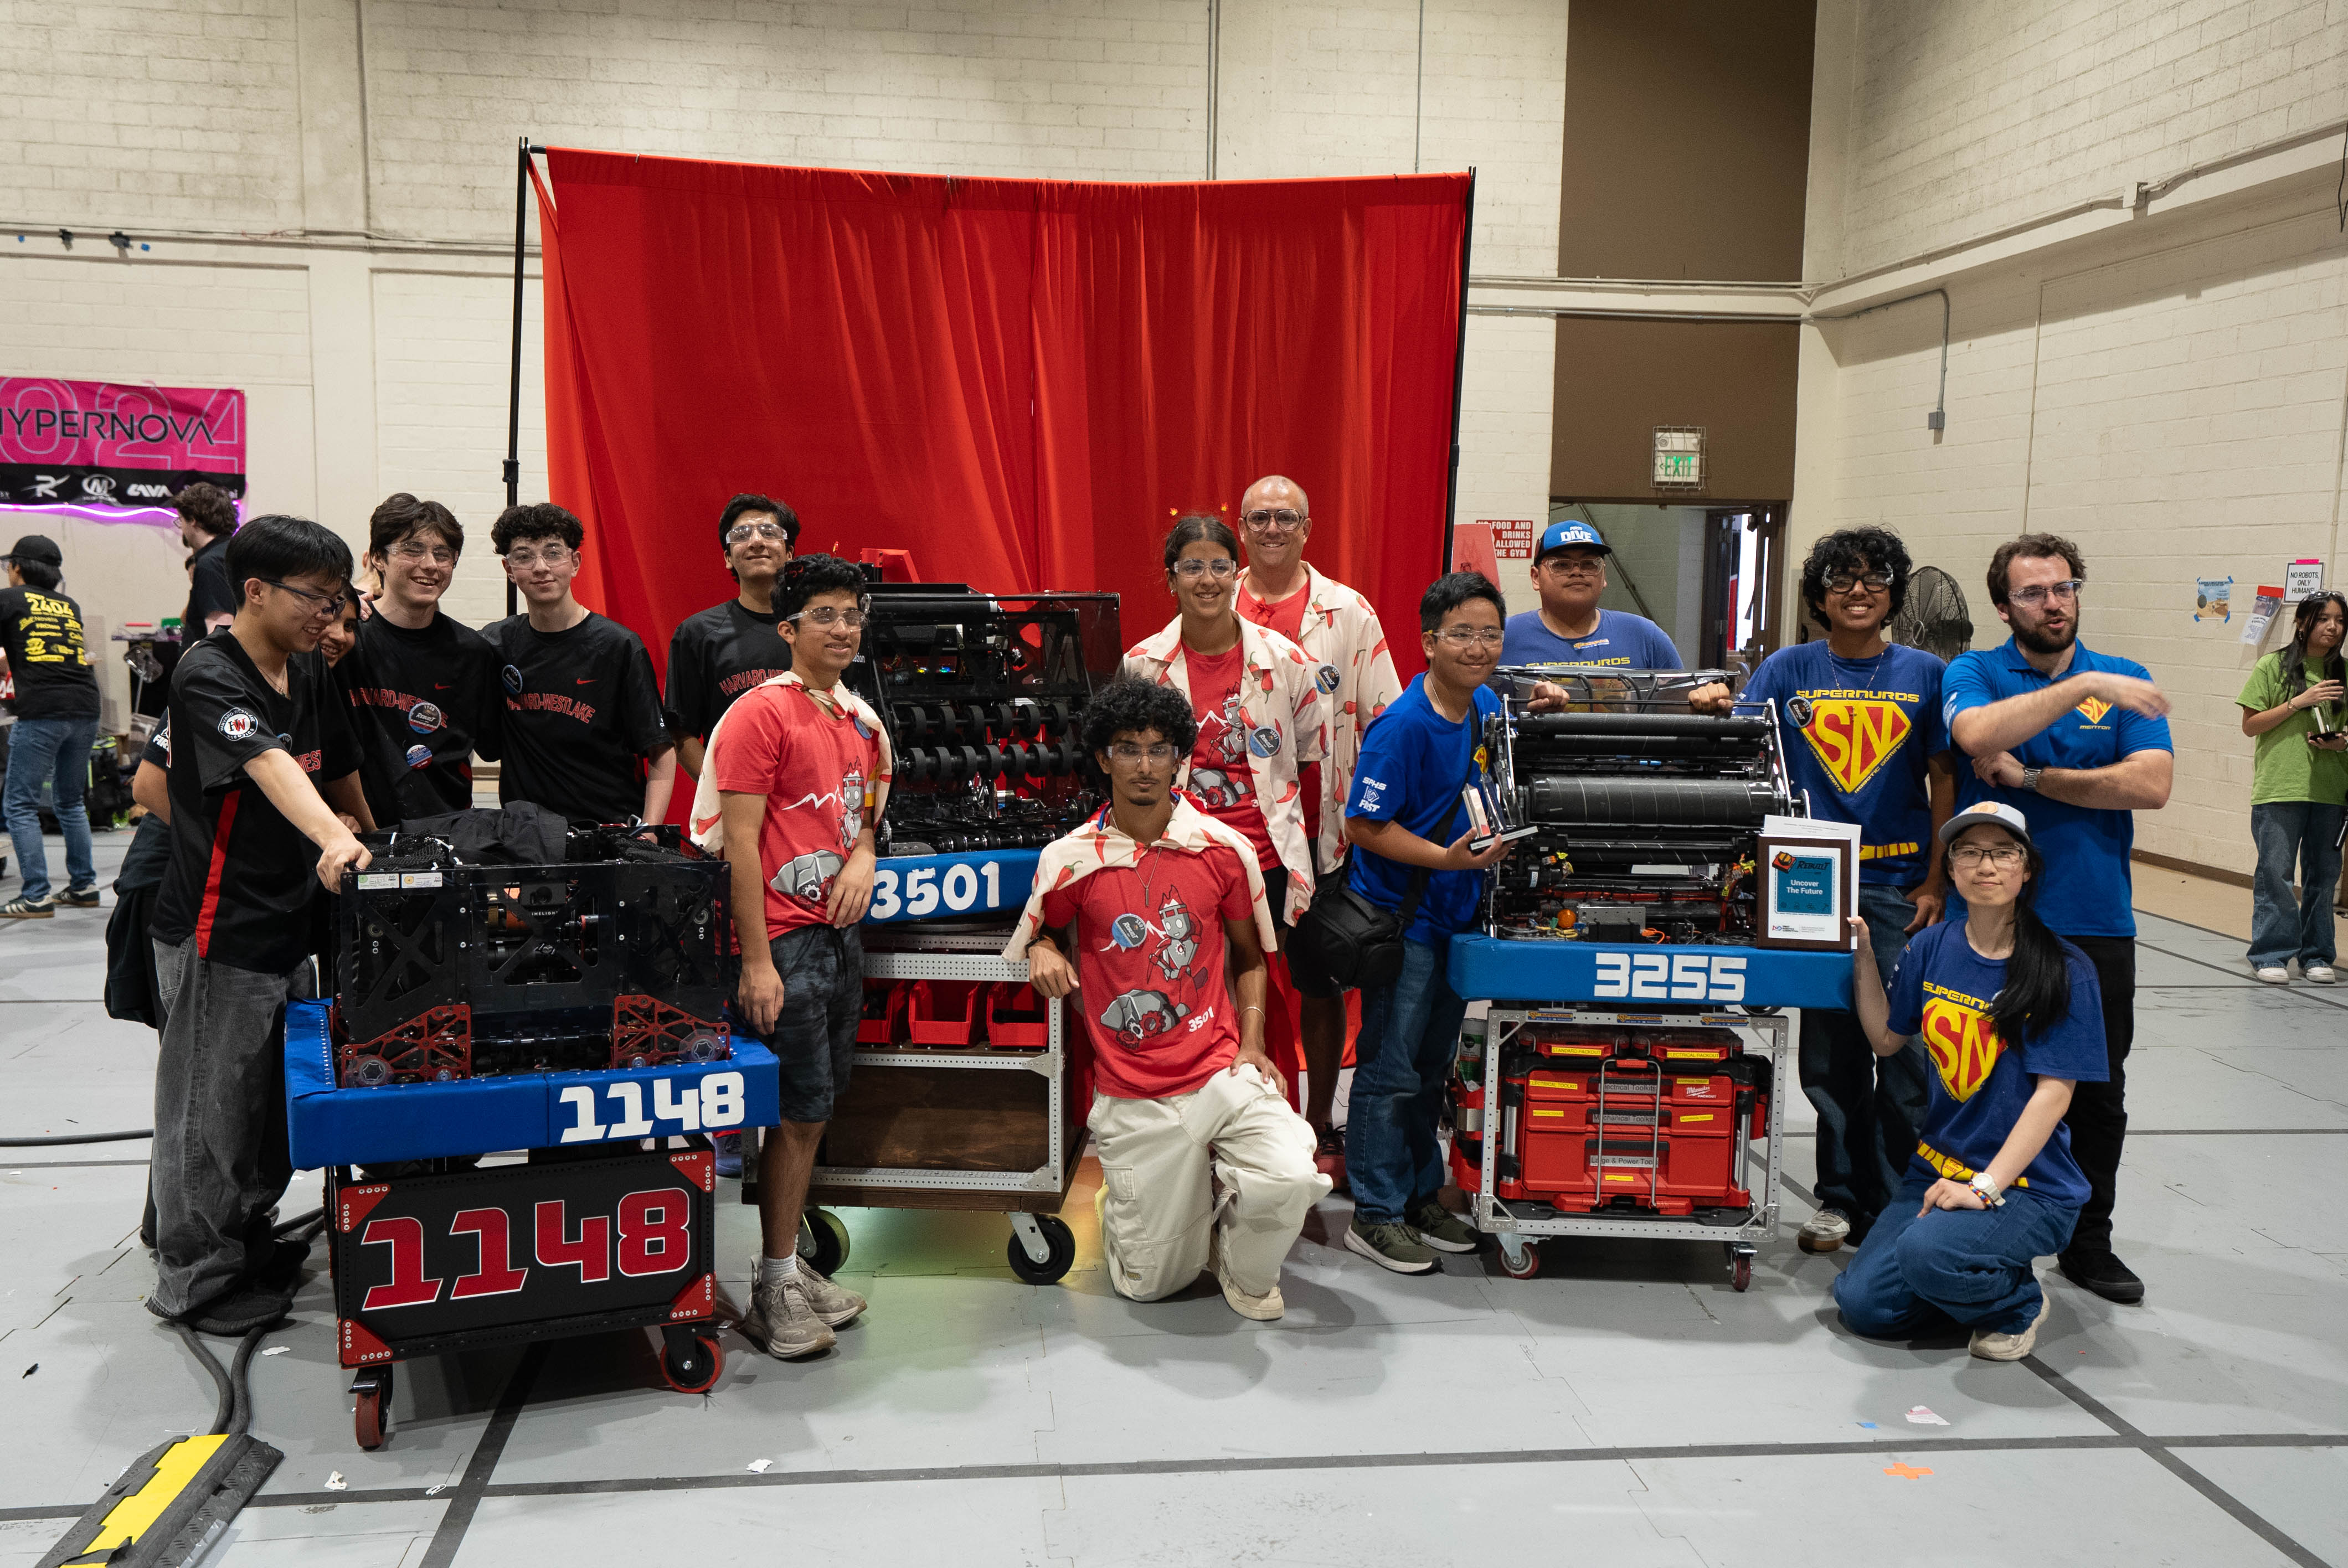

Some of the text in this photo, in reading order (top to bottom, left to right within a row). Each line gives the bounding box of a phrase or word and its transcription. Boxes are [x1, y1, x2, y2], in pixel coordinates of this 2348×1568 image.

[0, 408, 215, 446] YPERNOVA
[1665, 456, 1693, 477] EXIT
[1492, 521, 1531, 530] FOOD AND
[1502, 530, 1531, 539] DRINKS
[1495, 539, 1531, 548] ALLOWED
[1561, 530, 1594, 541] DIVE
[1510, 549, 1527, 558] GYM
[27, 598, 74, 616] 2404
[1796, 689, 1919, 703] SUPERNURDS
[1362, 776, 1387, 791] SPHS
[1854, 766, 1881, 793] ROBOTIC
[1796, 860, 1830, 870] REBUILT
[870, 860, 1000, 920] 3501
[1594, 952, 1747, 1002] 3255
[1188, 1006, 1214, 1033] 3501
[560, 1071, 745, 1144] 1148
[361, 1187, 690, 1312] 1148
